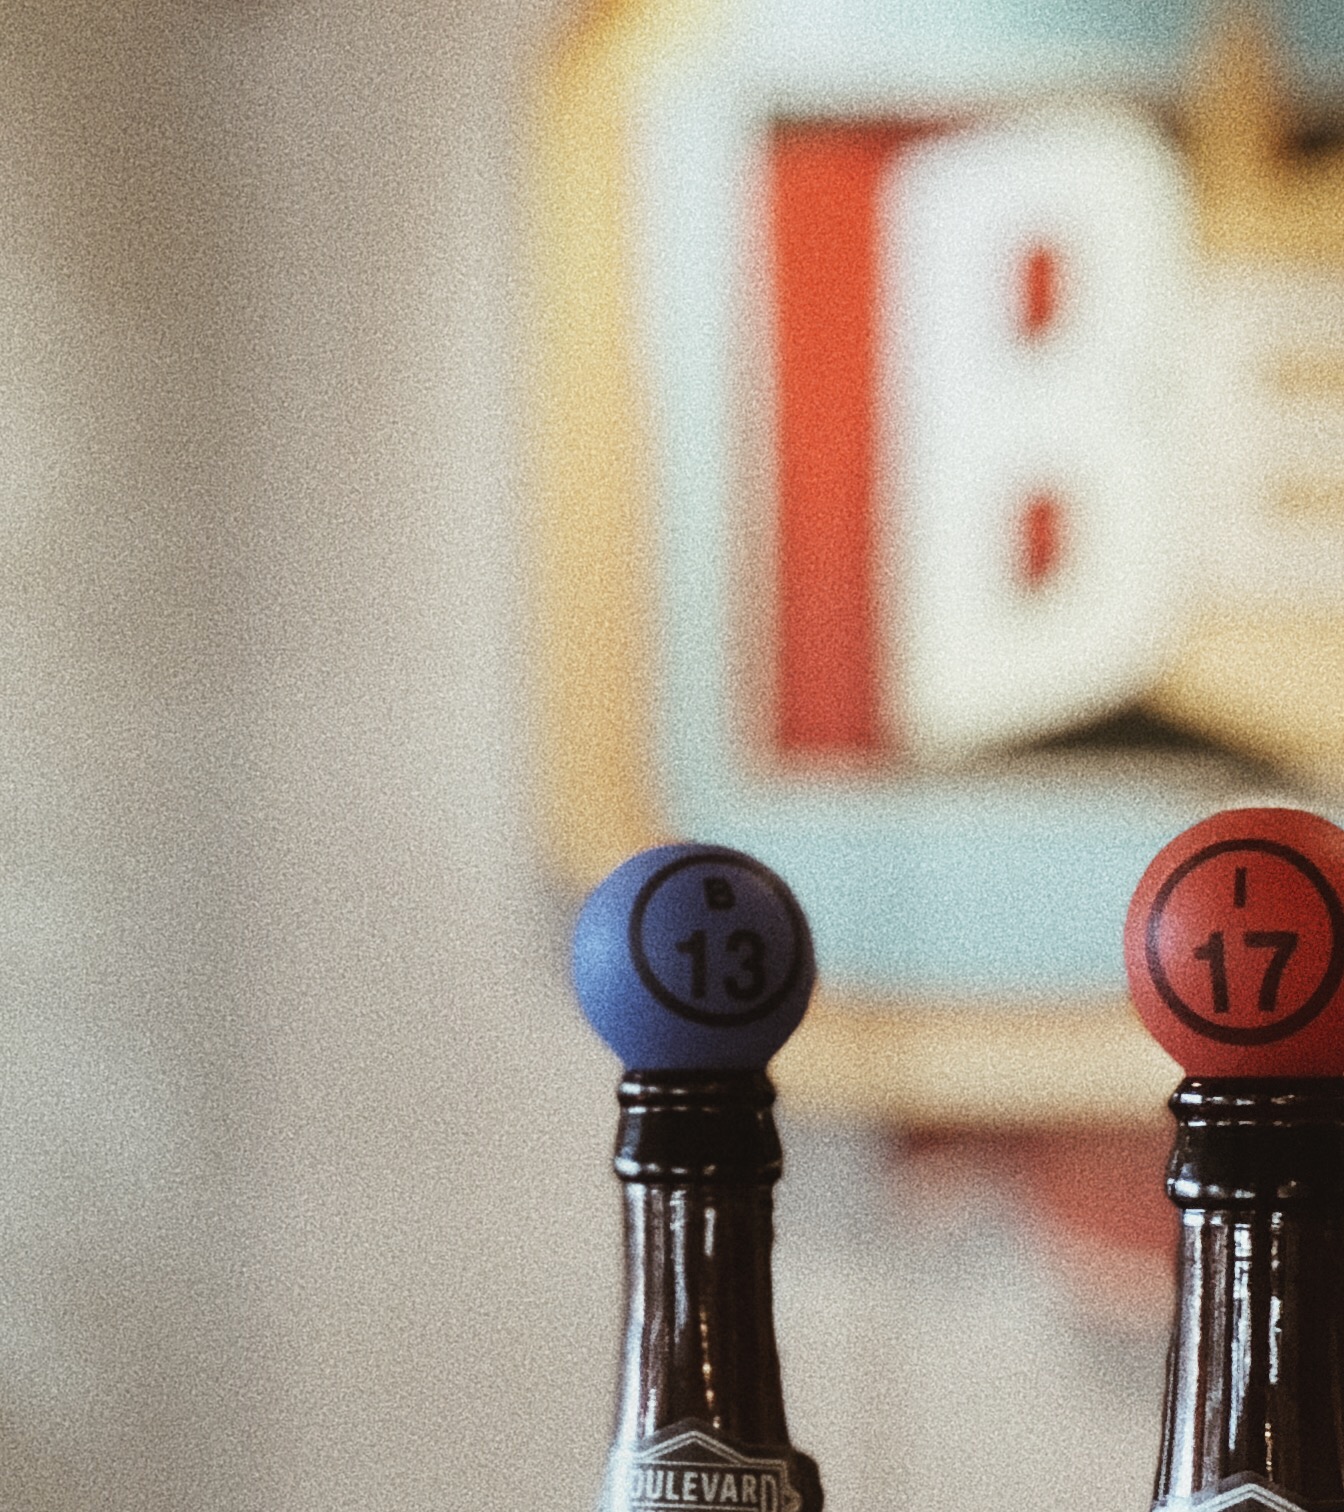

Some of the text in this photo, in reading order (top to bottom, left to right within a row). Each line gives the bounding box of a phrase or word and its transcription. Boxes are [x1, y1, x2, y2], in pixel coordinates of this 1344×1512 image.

[703, 877, 736, 911] B
[1234, 867, 1247, 908] I
[675, 928, 766, 1000] 13
[1194, 930, 1298, 1013] 17
